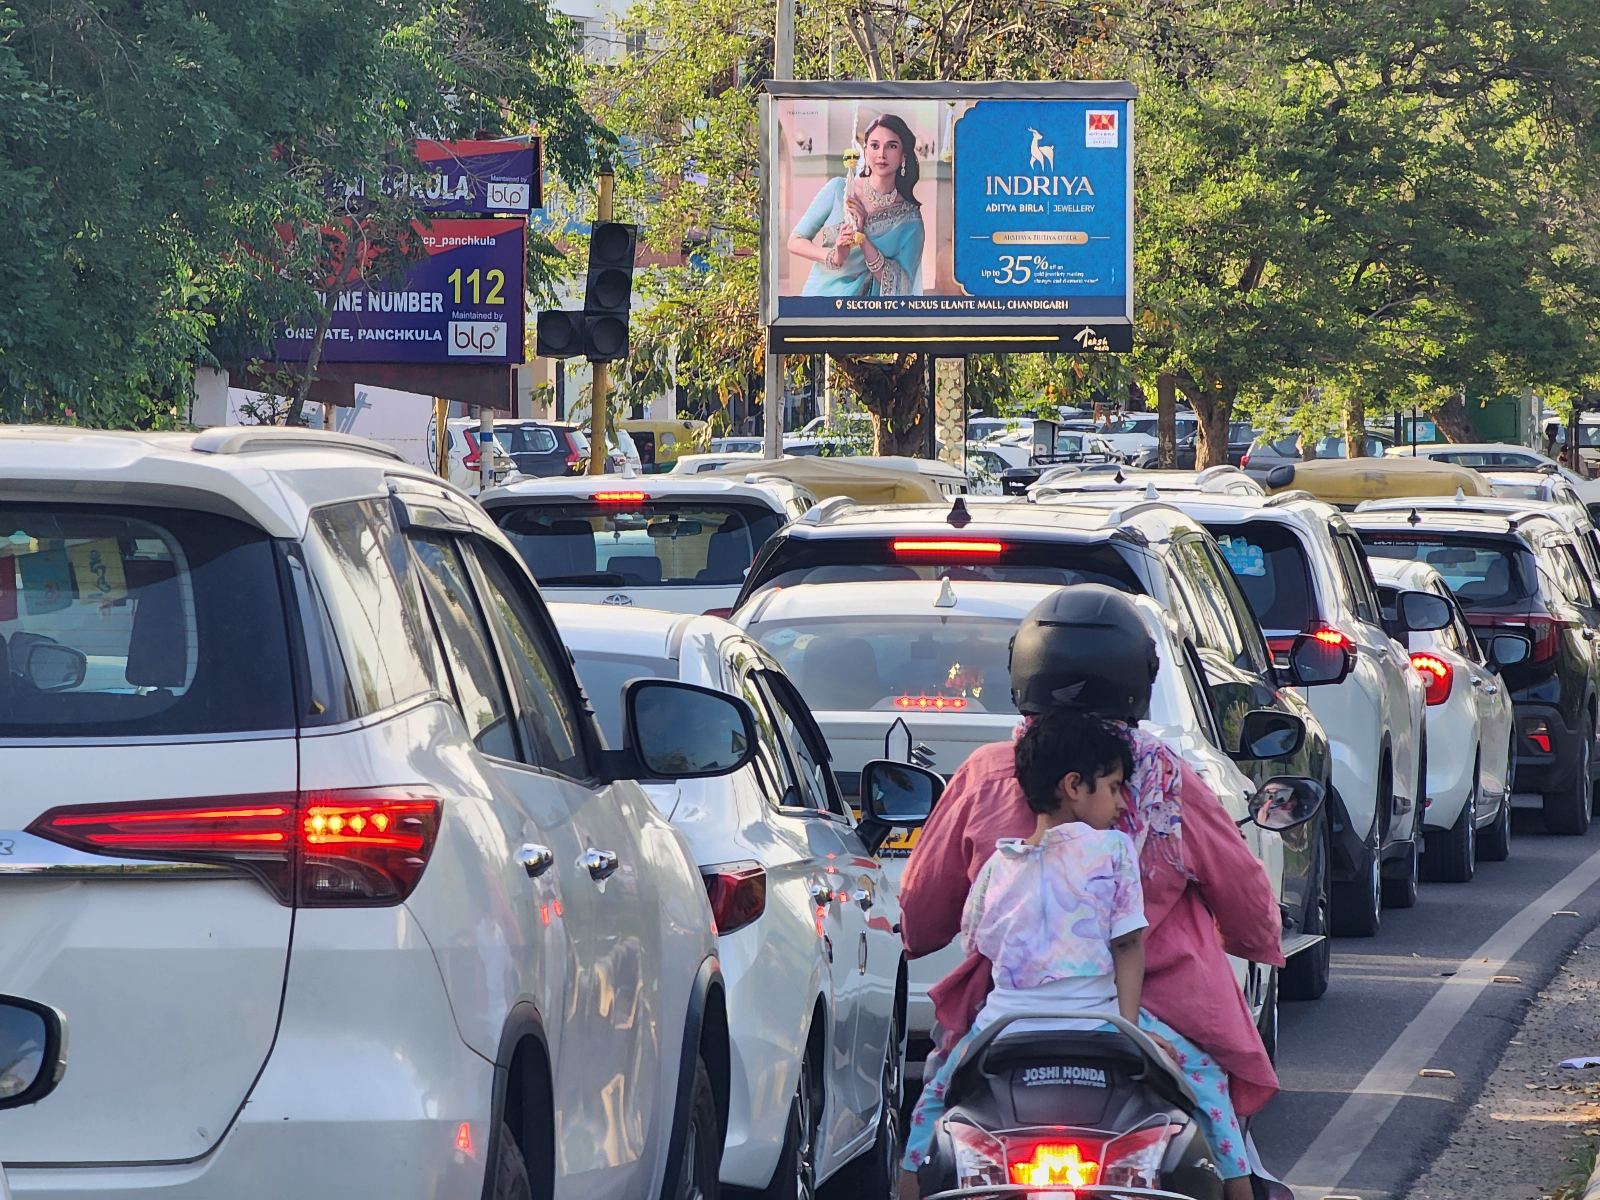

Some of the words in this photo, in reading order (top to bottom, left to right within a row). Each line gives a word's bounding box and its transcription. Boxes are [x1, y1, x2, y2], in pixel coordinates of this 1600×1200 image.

[520, 176, 528, 184] by
[985, 175, 1095, 195] INDRIYA
[492, 184, 521, 206] blp
[985, 203, 1017, 213] ADITYA
[1019, 203, 1044, 213] BIRLA
[1053, 204, 1096, 213] JEWELLERY
[981, 269, 992, 279] Up
[992, 269, 1000, 277] to
[994, 255, 1049, 285] 35%
[368, 291, 443, 312] NUMBER
[448, 268, 505, 305] 112
[846, 300, 881, 310] SECTOR
[884, 300, 898, 310] 17C
[908, 300, 938, 310] NEXUS
[940, 300, 975, 310] ELANTE
[977, 300, 1005, 310] MALL,
[1007, 300, 1069, 310] CHANDIGARH
[451, 310, 492, 320] Maintained
[494, 311, 504, 321] by
[358, 329, 442, 341] PANCHKULA
[454, 323, 495, 354] blp
[1022, 1066, 1060, 1082] JOSHI
[1062, 1066, 1106, 1083] HONDA
